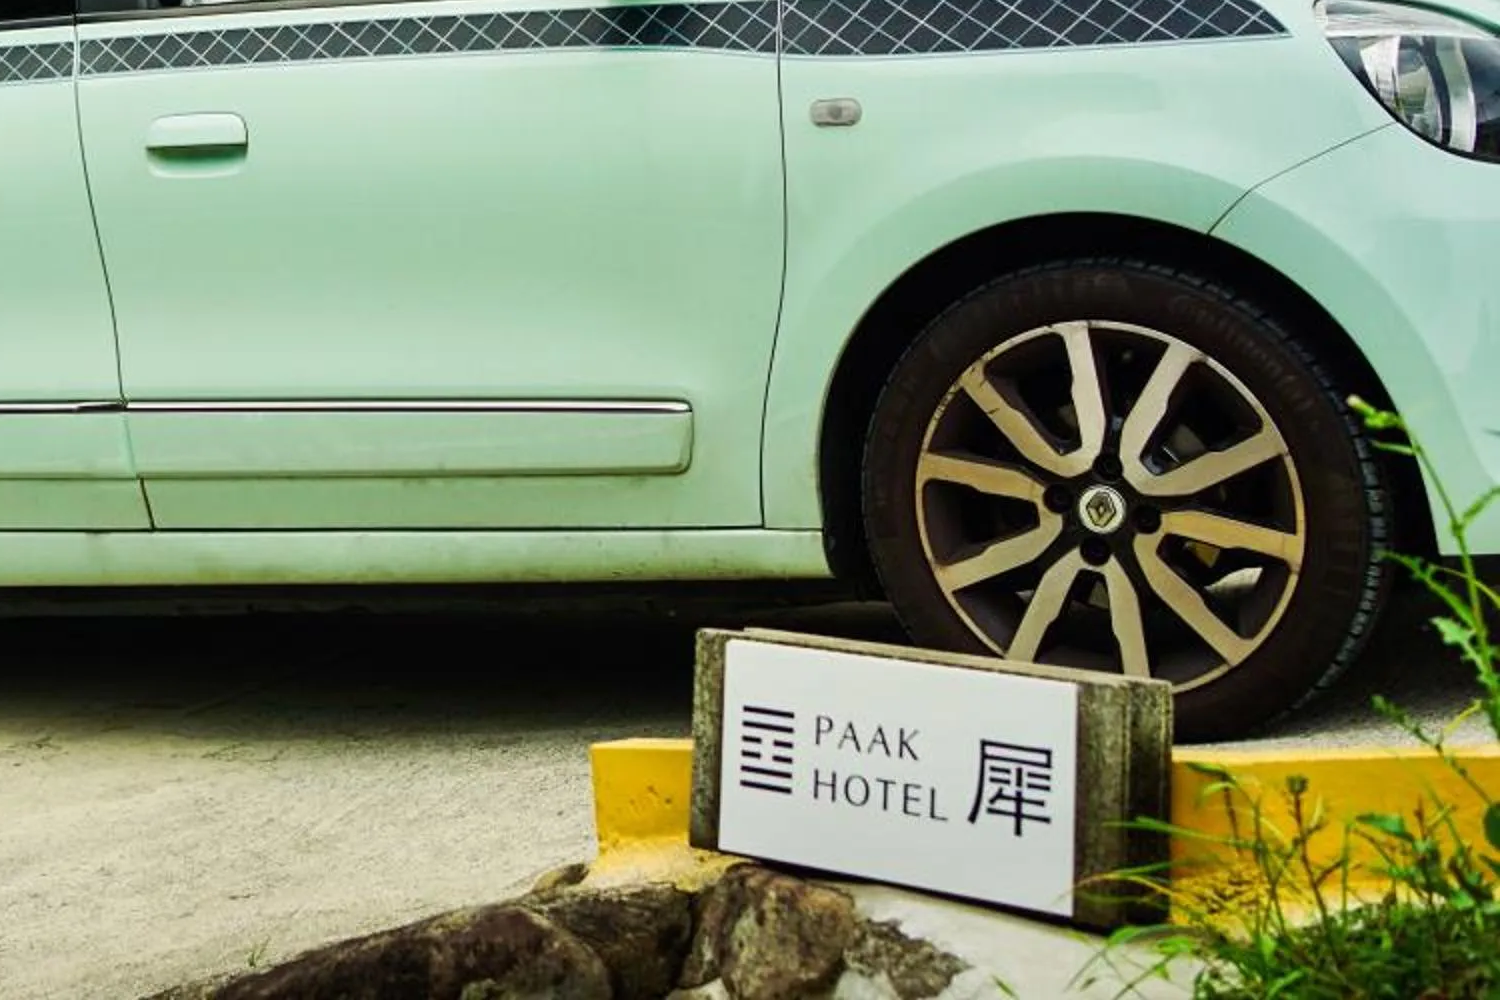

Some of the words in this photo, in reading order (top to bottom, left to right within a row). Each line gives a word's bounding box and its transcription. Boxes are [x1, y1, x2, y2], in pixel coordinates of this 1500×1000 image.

[815, 714, 920, 762] PAAK
[813, 767, 949, 822] HOTEL
[967, 738, 1053, 837] 犀
